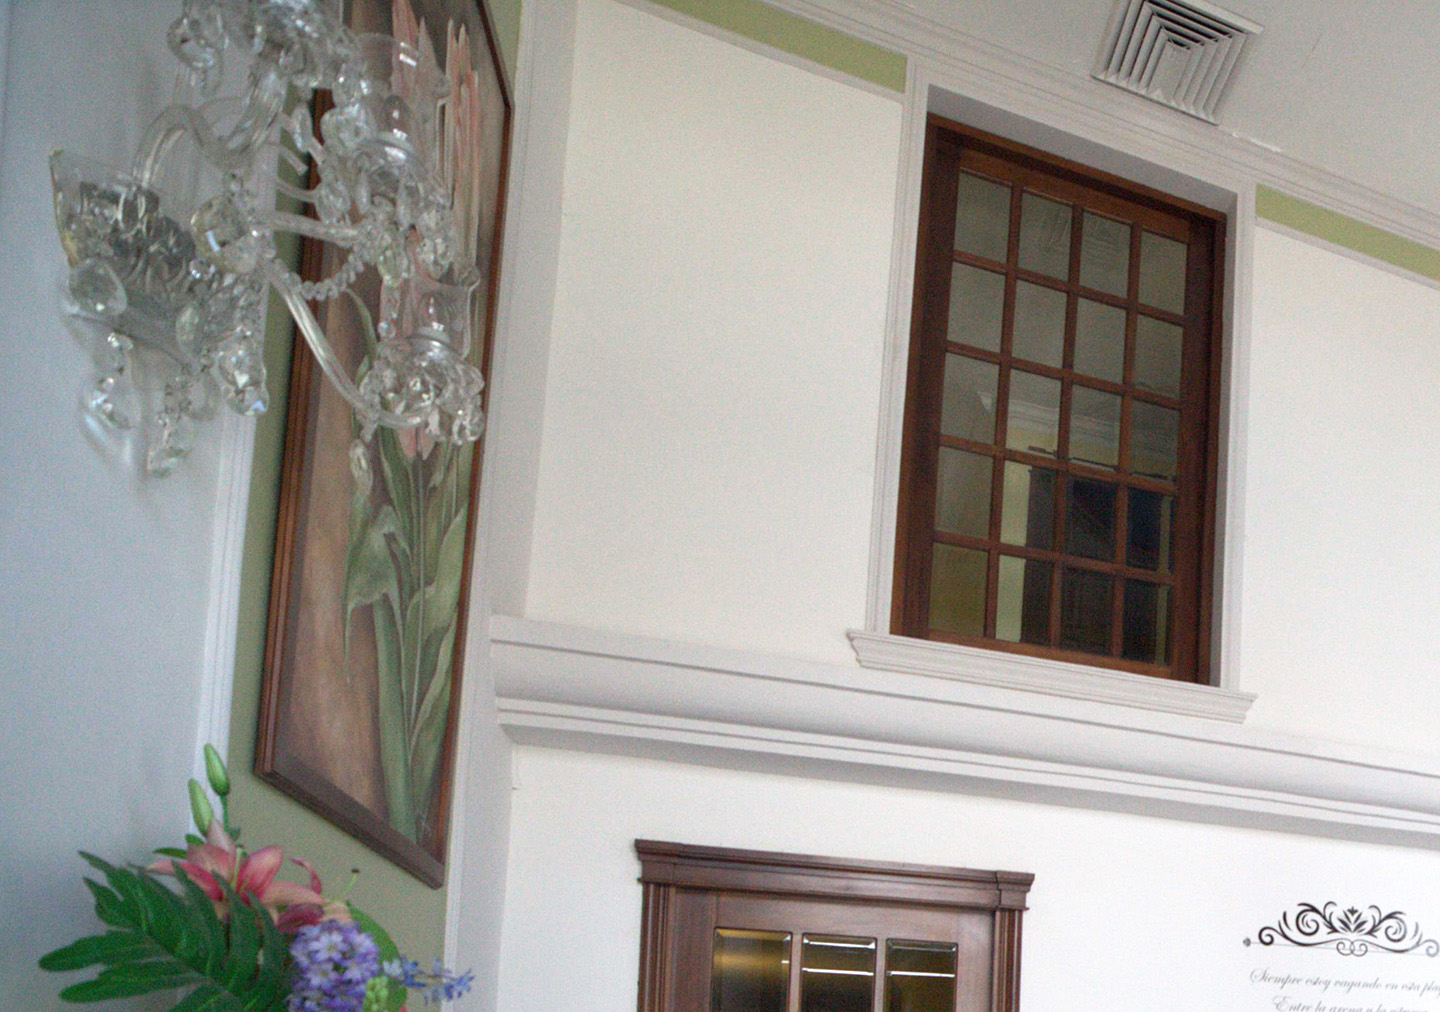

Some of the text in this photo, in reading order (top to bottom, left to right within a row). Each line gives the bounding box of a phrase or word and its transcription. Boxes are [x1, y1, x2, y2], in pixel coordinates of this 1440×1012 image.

[1249, 967, 1303, 990] Siempre
[1305, 976, 1331, 993] estoy
[1333, 977, 1382, 994] vagando
[1385, 983, 1399, 991] en
[1401, 981, 1421, 992] esta
[1272, 995, 1313, 1012] Entre
[1315, 1000, 1327, 1012] la
